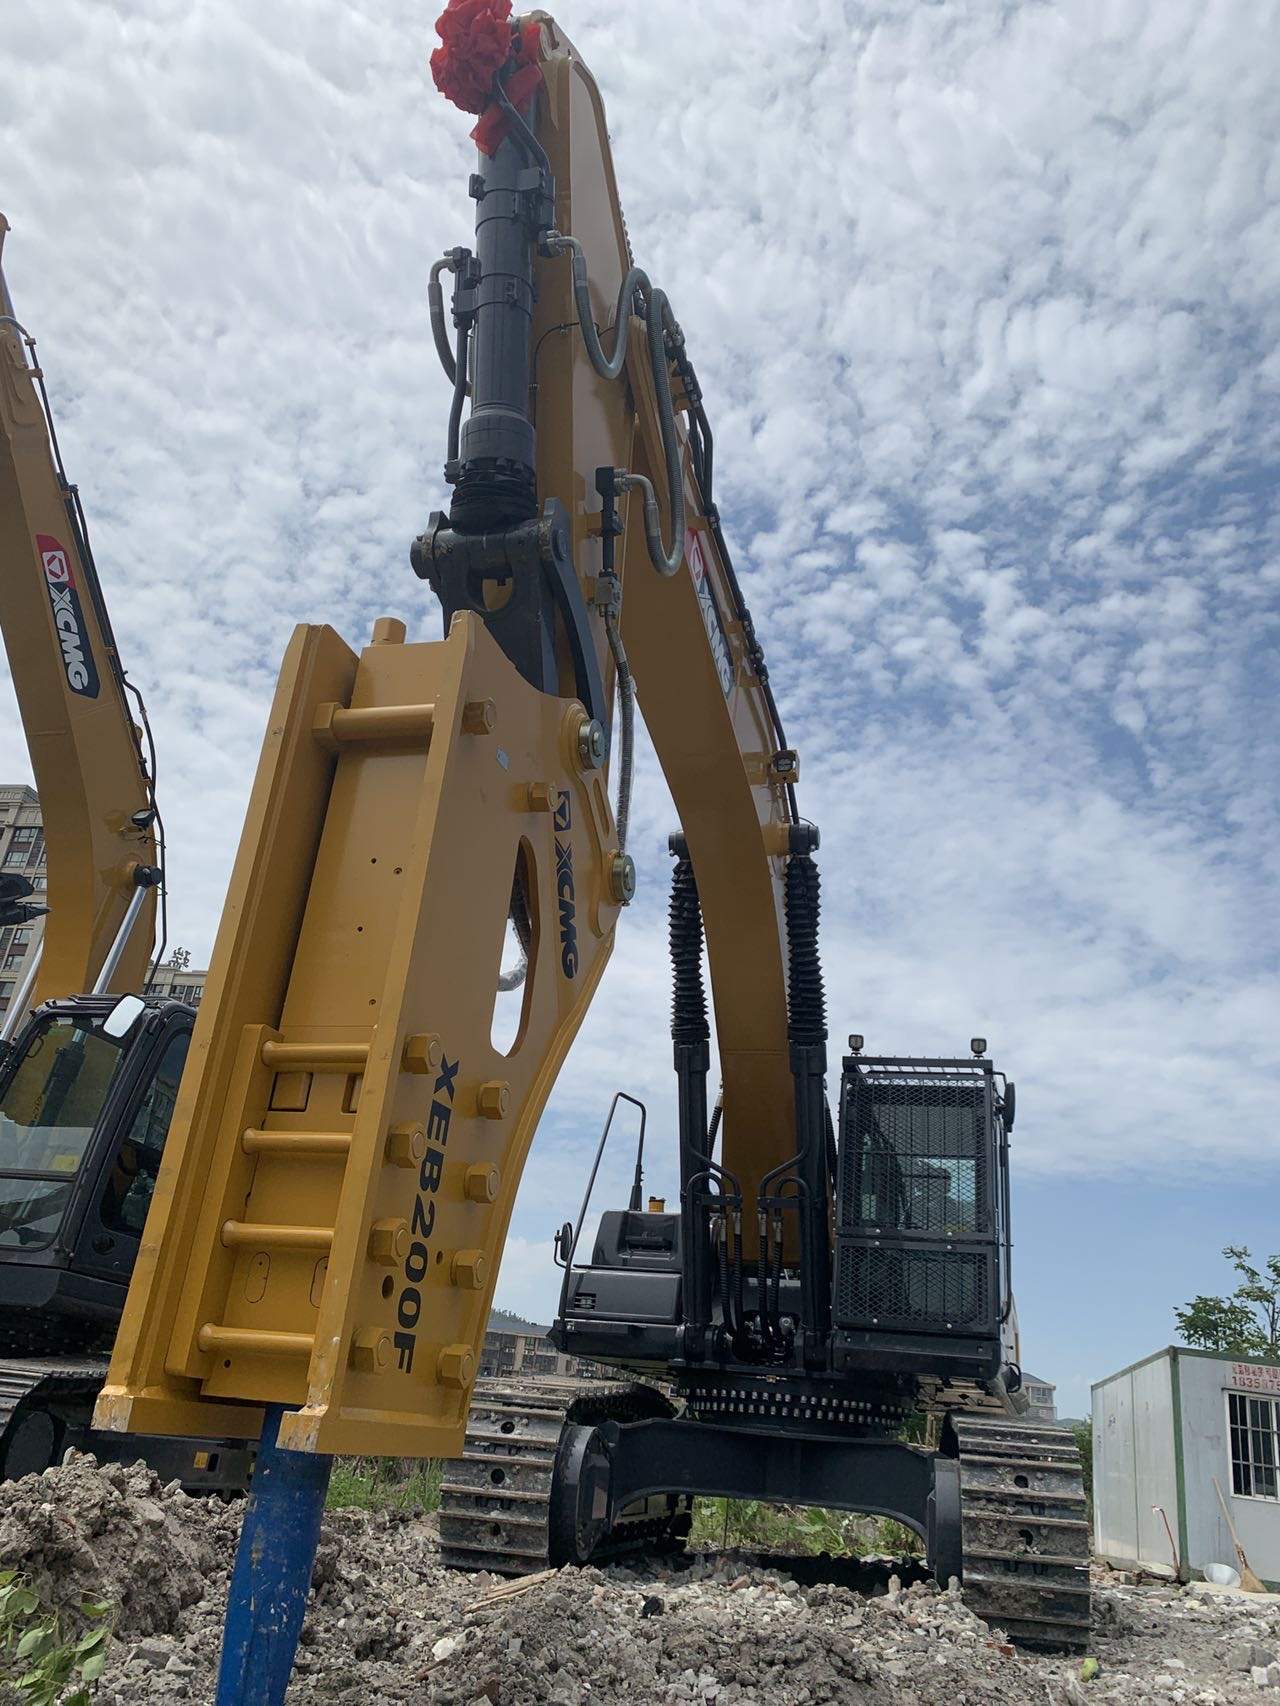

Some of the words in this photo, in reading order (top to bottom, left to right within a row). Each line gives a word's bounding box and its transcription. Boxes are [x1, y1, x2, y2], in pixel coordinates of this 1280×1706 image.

[48, 583, 89, 690] XCMG
[698, 576, 733, 694] XCMG
[555, 835, 579, 979] XCMG
[394, 1053, 460, 1375] XEB200F
